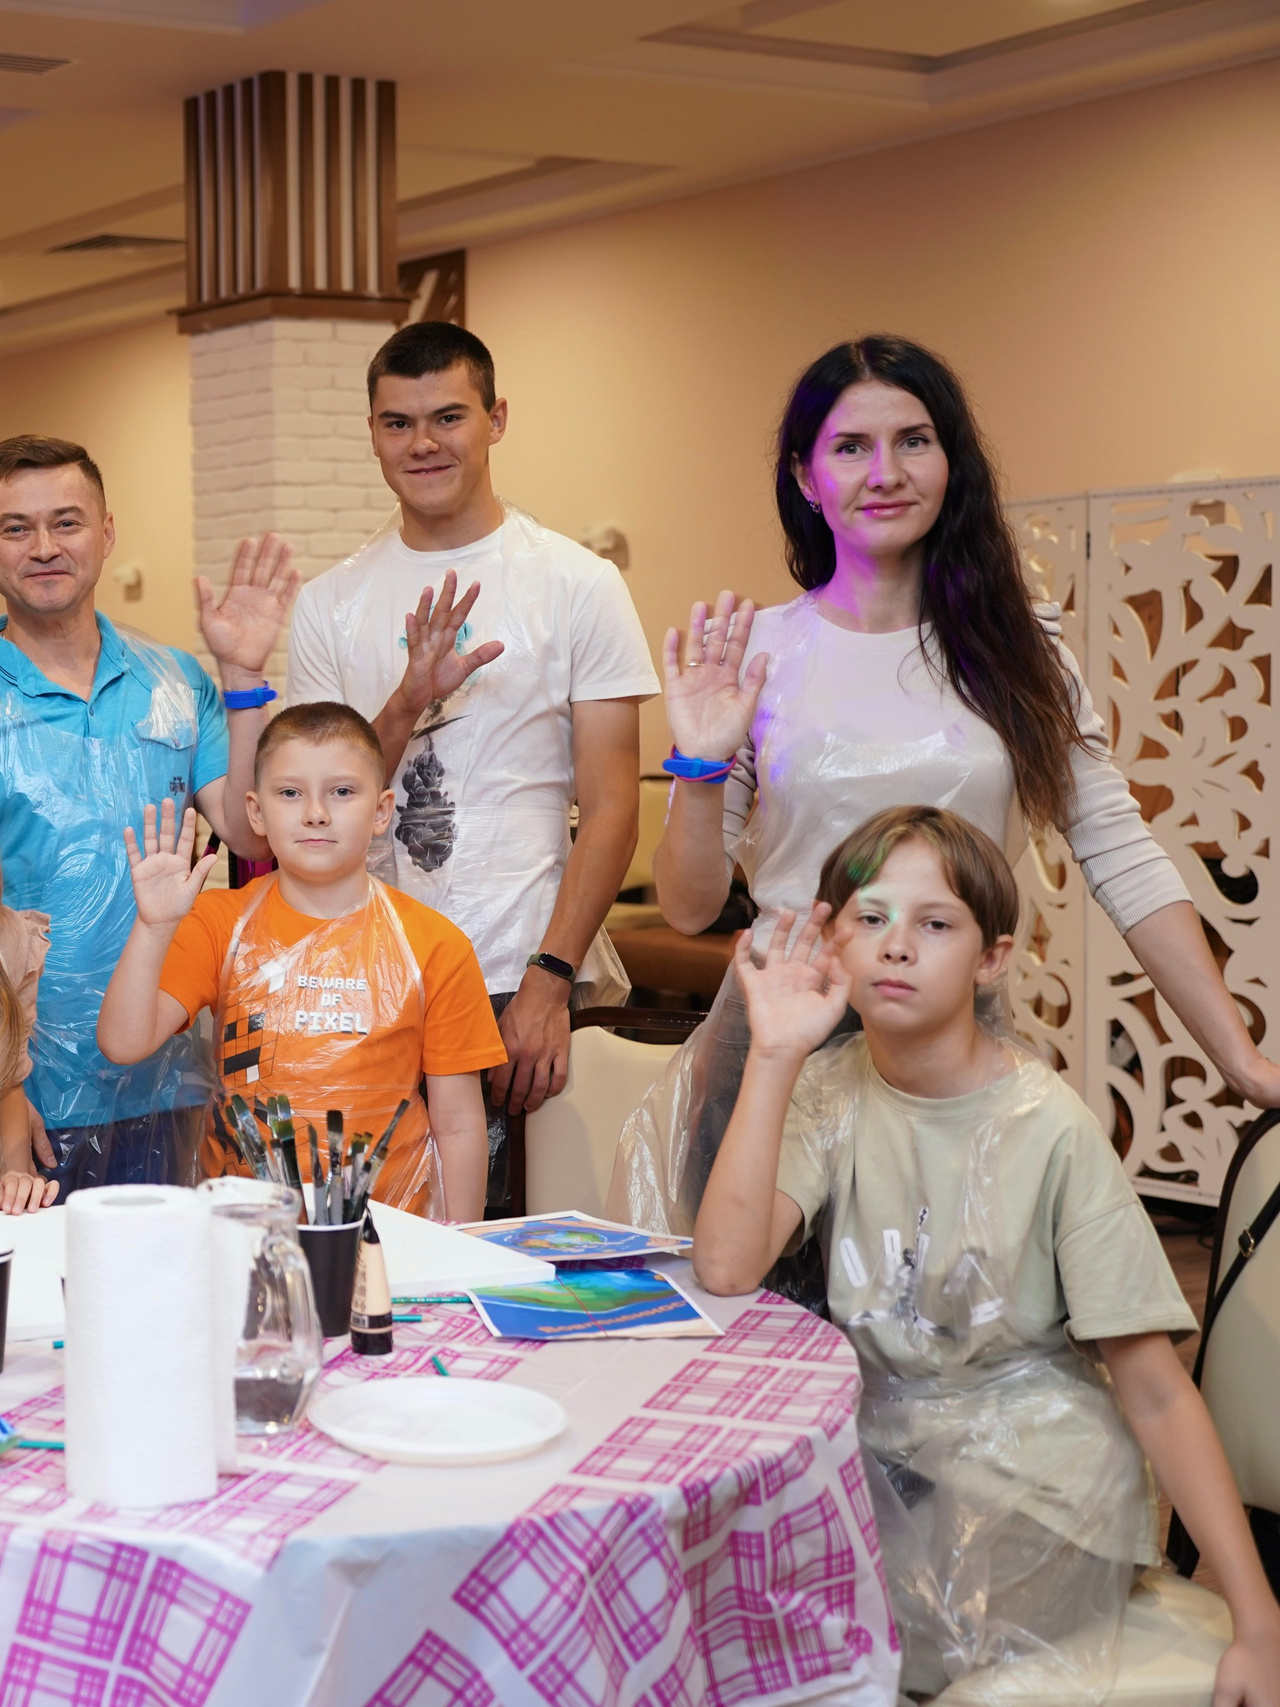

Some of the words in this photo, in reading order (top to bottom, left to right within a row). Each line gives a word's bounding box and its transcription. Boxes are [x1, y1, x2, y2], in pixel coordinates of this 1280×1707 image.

[297, 975, 367, 991] BEWARE
[321, 993, 343, 1008] OF
[294, 1010, 369, 1035] PIXEL
